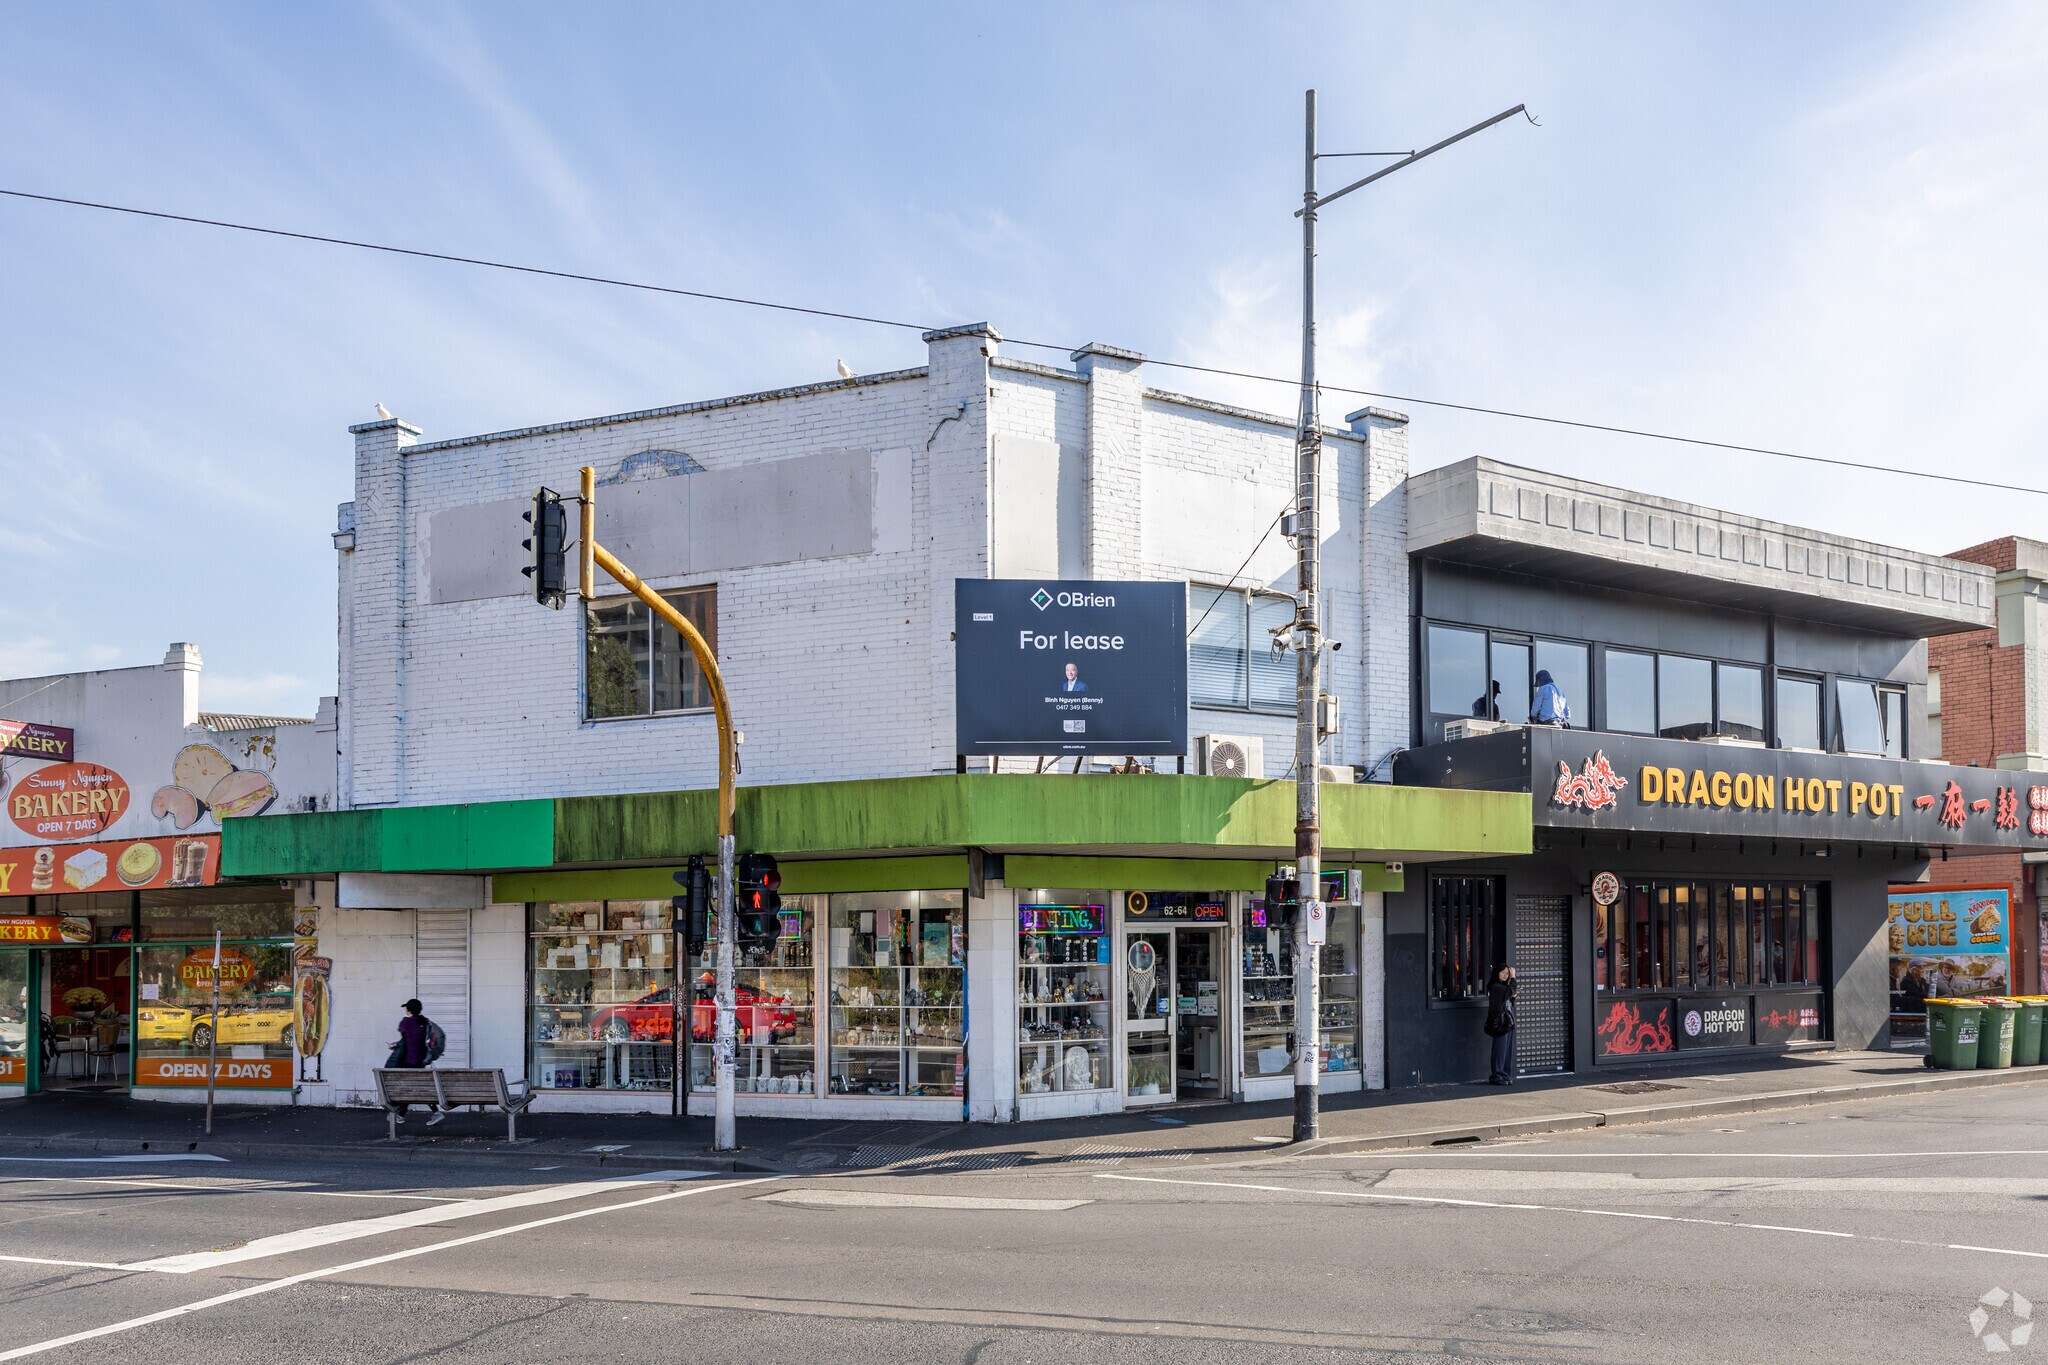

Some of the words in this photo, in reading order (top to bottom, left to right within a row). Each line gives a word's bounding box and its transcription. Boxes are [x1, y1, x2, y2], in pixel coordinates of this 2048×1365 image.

[1057, 592, 1115, 608] OBrien
[1020, 631, 1058, 650] For
[1064, 630, 1125, 650] lease
[25, 726, 55, 738] Nguyen
[27, 773, 67, 792] Sunny
[72, 769, 113, 788] Nguyen
[1640, 765, 1776, 810] DRAGON
[1784, 776, 1843, 814] HOT
[1850, 781, 1904, 817] POT
[13, 787, 127, 819] BAKERY
[37, 821, 63, 833] OPEN
[66, 821, 72, 831] 7
[75, 818, 97, 830] DAYS
[1164, 905, 1187, 916] 62-64
[1195, 906, 1224, 918] OPEN
[1888, 900, 1957, 923] FULL
[1970, 934, 2001, 944] COOKIE
[182, 963, 251, 979] BAKERY
[1704, 1009, 1745, 1022] DRAGON
[1704, 1022, 1724, 1034] HOT
[1726, 1021, 1745, 1033] POT
[160, 1063, 207, 1078] OPEN
[229, 1063, 272, 1079] DAYS
